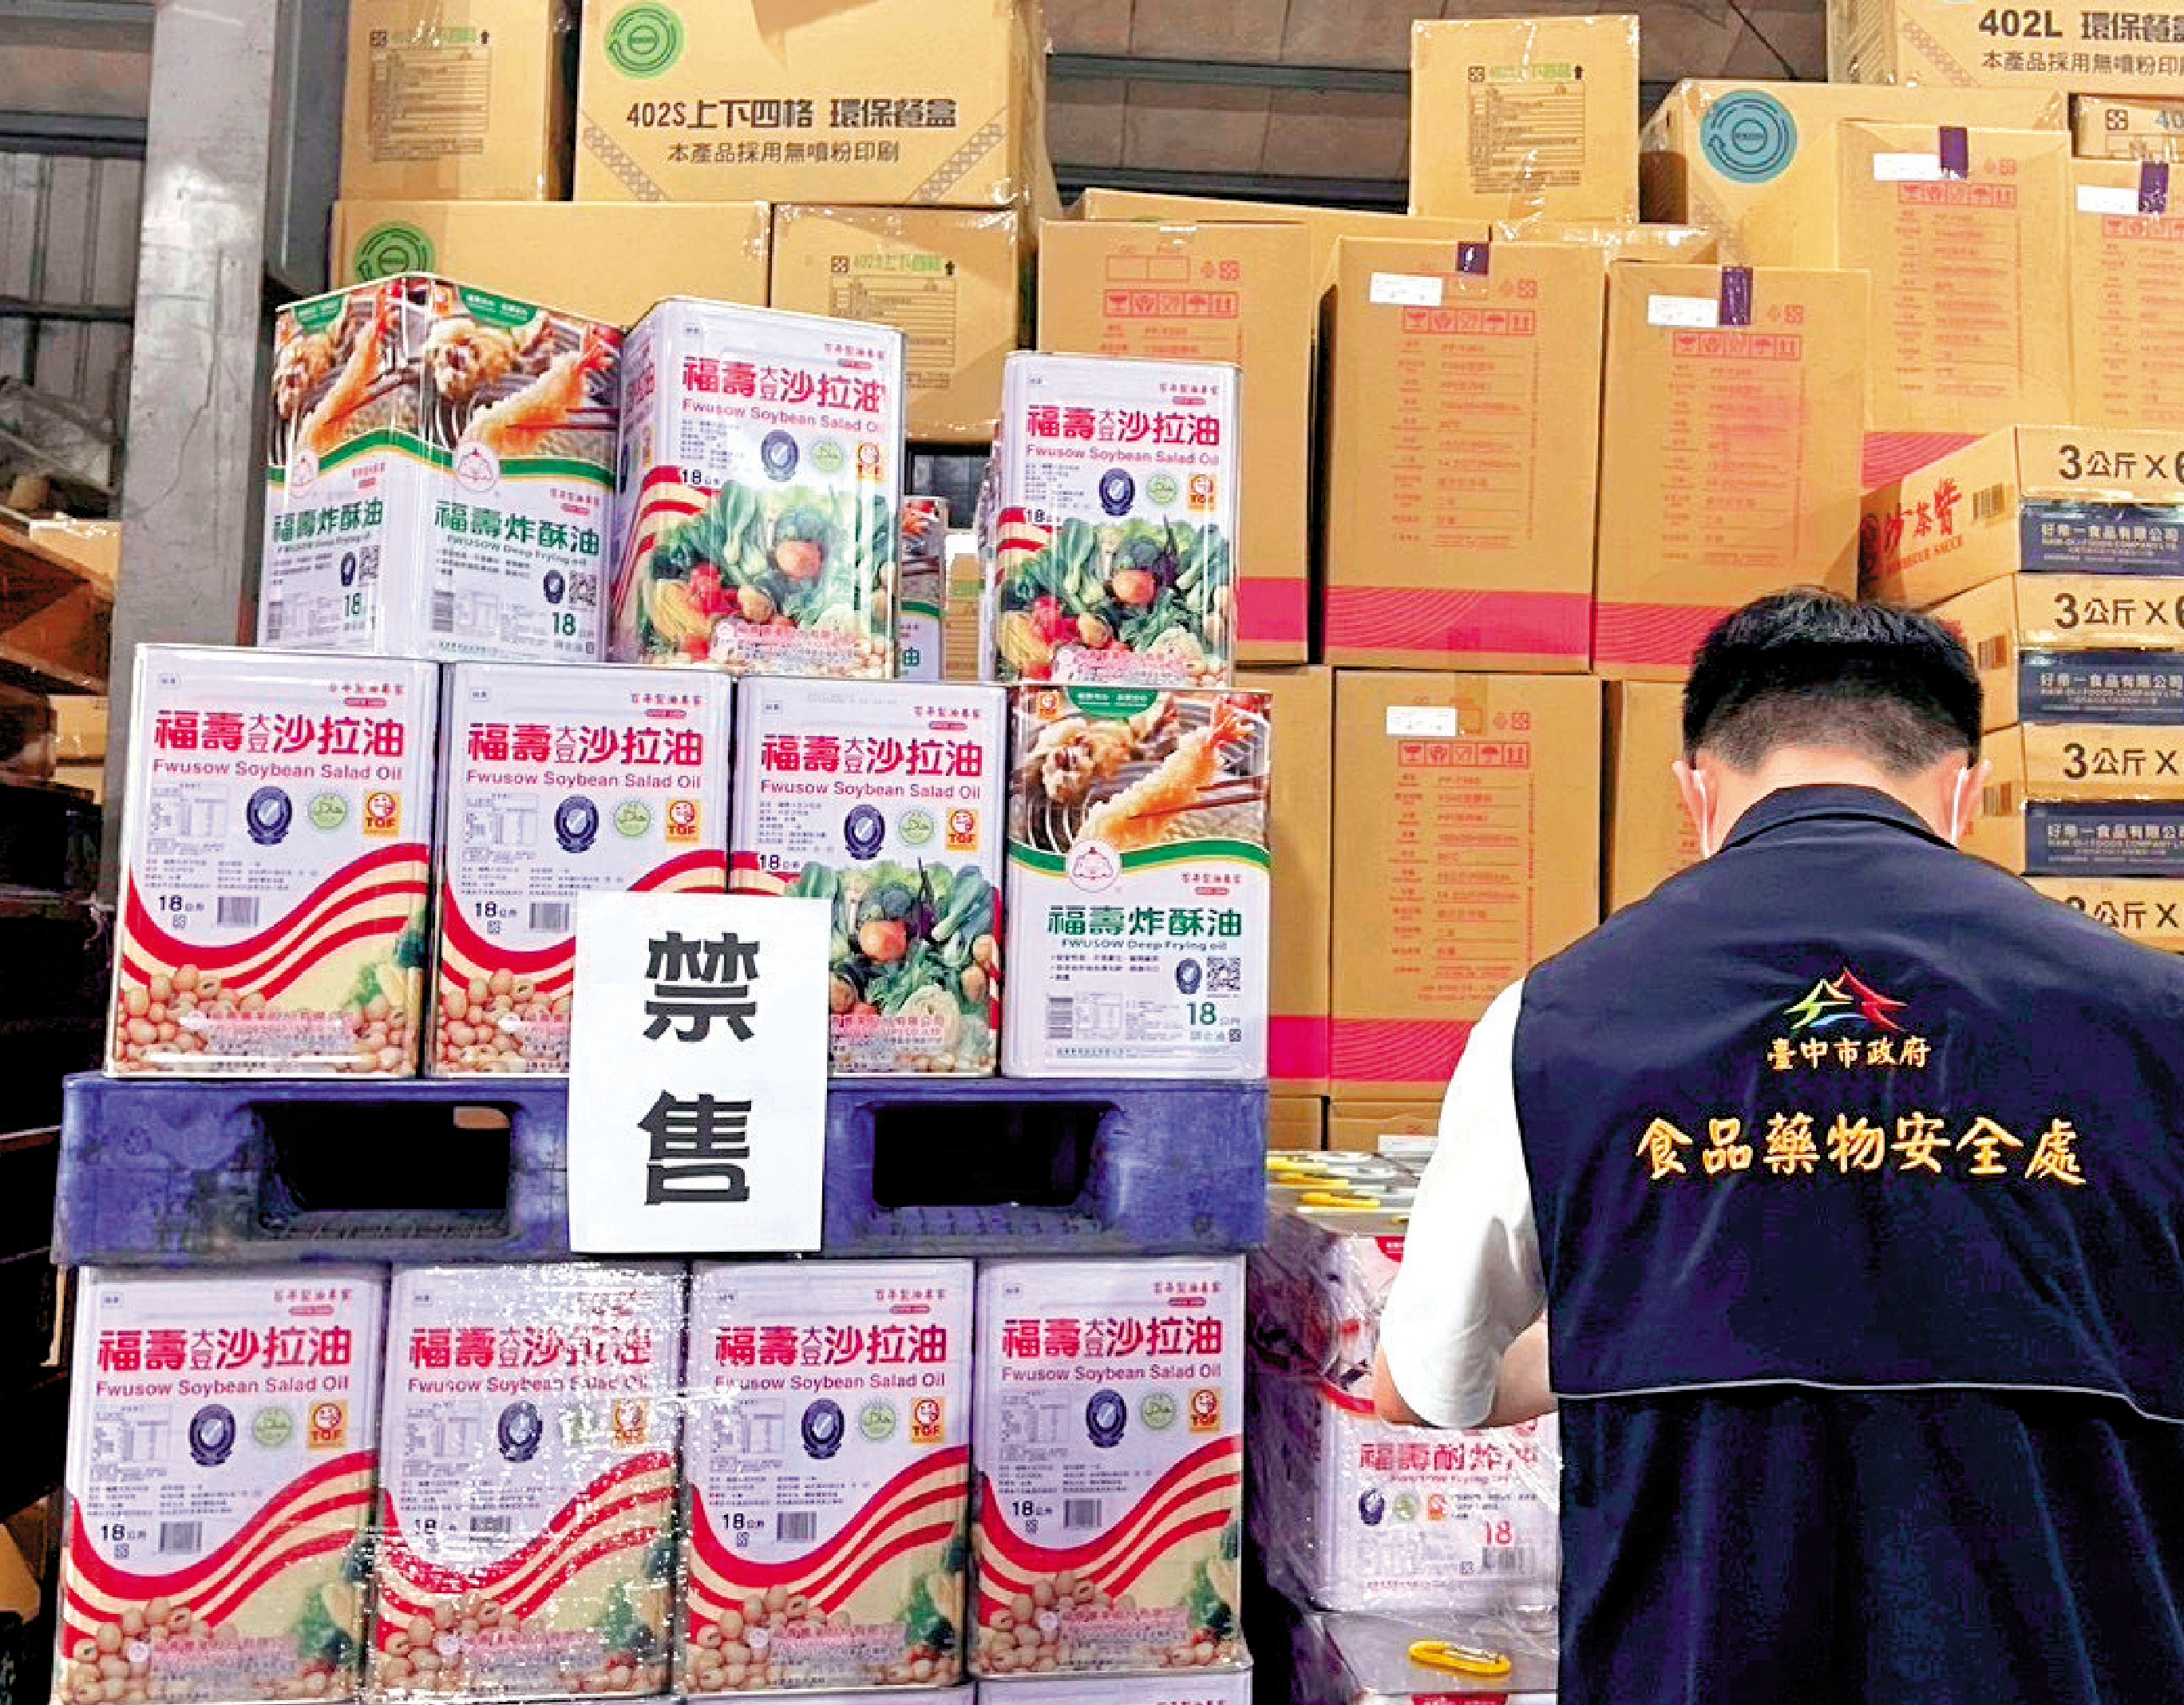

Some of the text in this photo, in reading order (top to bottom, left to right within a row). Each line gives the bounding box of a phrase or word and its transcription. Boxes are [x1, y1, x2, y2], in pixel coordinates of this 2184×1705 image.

[1979, 9, 2063, 38] 402L
[627, 99, 957, 130] 402S上下四格 環保餐盒
[682, 398, 746, 418] Fwusow
[751, 406, 816, 425] Soybean
[1027, 404, 1220, 445] 福壽大豆沙拉油
[1027, 445, 1085, 458] Fwusow
[1090, 446, 1152, 463] Soybean
[344, 593, 362, 616] 18
[552, 611, 576, 635] 18
[155, 710, 403, 757] 福壽大豆沙拉油
[468, 722, 702, 765] 福壽大豆沙拉油
[153, 758, 402, 781] Fwusow Soybean Salad Oil
[762, 734, 983, 777] 福壽大豆沙拉油
[467, 769, 701, 790] Fwusow Soybean Salad Oil
[761, 780, 980, 799] Fwusow Soybean Salad Oil
[1047, 904, 1242, 937] 福壽炸酥油
[1187, 1002, 1217, 1025] 18
[637, 930, 761, 1206] 禁售
[1766, 1037, 1932, 1071] 臺中市政府
[1635, 1111, 2086, 1186] 食品藥物安全處
[97, 1325, 352, 1371] 福壽大豆沙拉油
[715, 1325, 947, 1367] 福壽大豆沙拉油
[1003, 1316, 1222, 1359] 福壽大豆沙拉油
[96, 1375, 348, 1398] Fwusow Soybean Salad Oil
[791, 1375, 864, 1393] Soybean
[871, 1374, 916, 1389] Salad
[922, 1372, 945, 1387] Oil
[1002, 1363, 1221, 1383] Fwusow Soybean Salad Oil
[1486, 1520, 1512, 1545] 18
